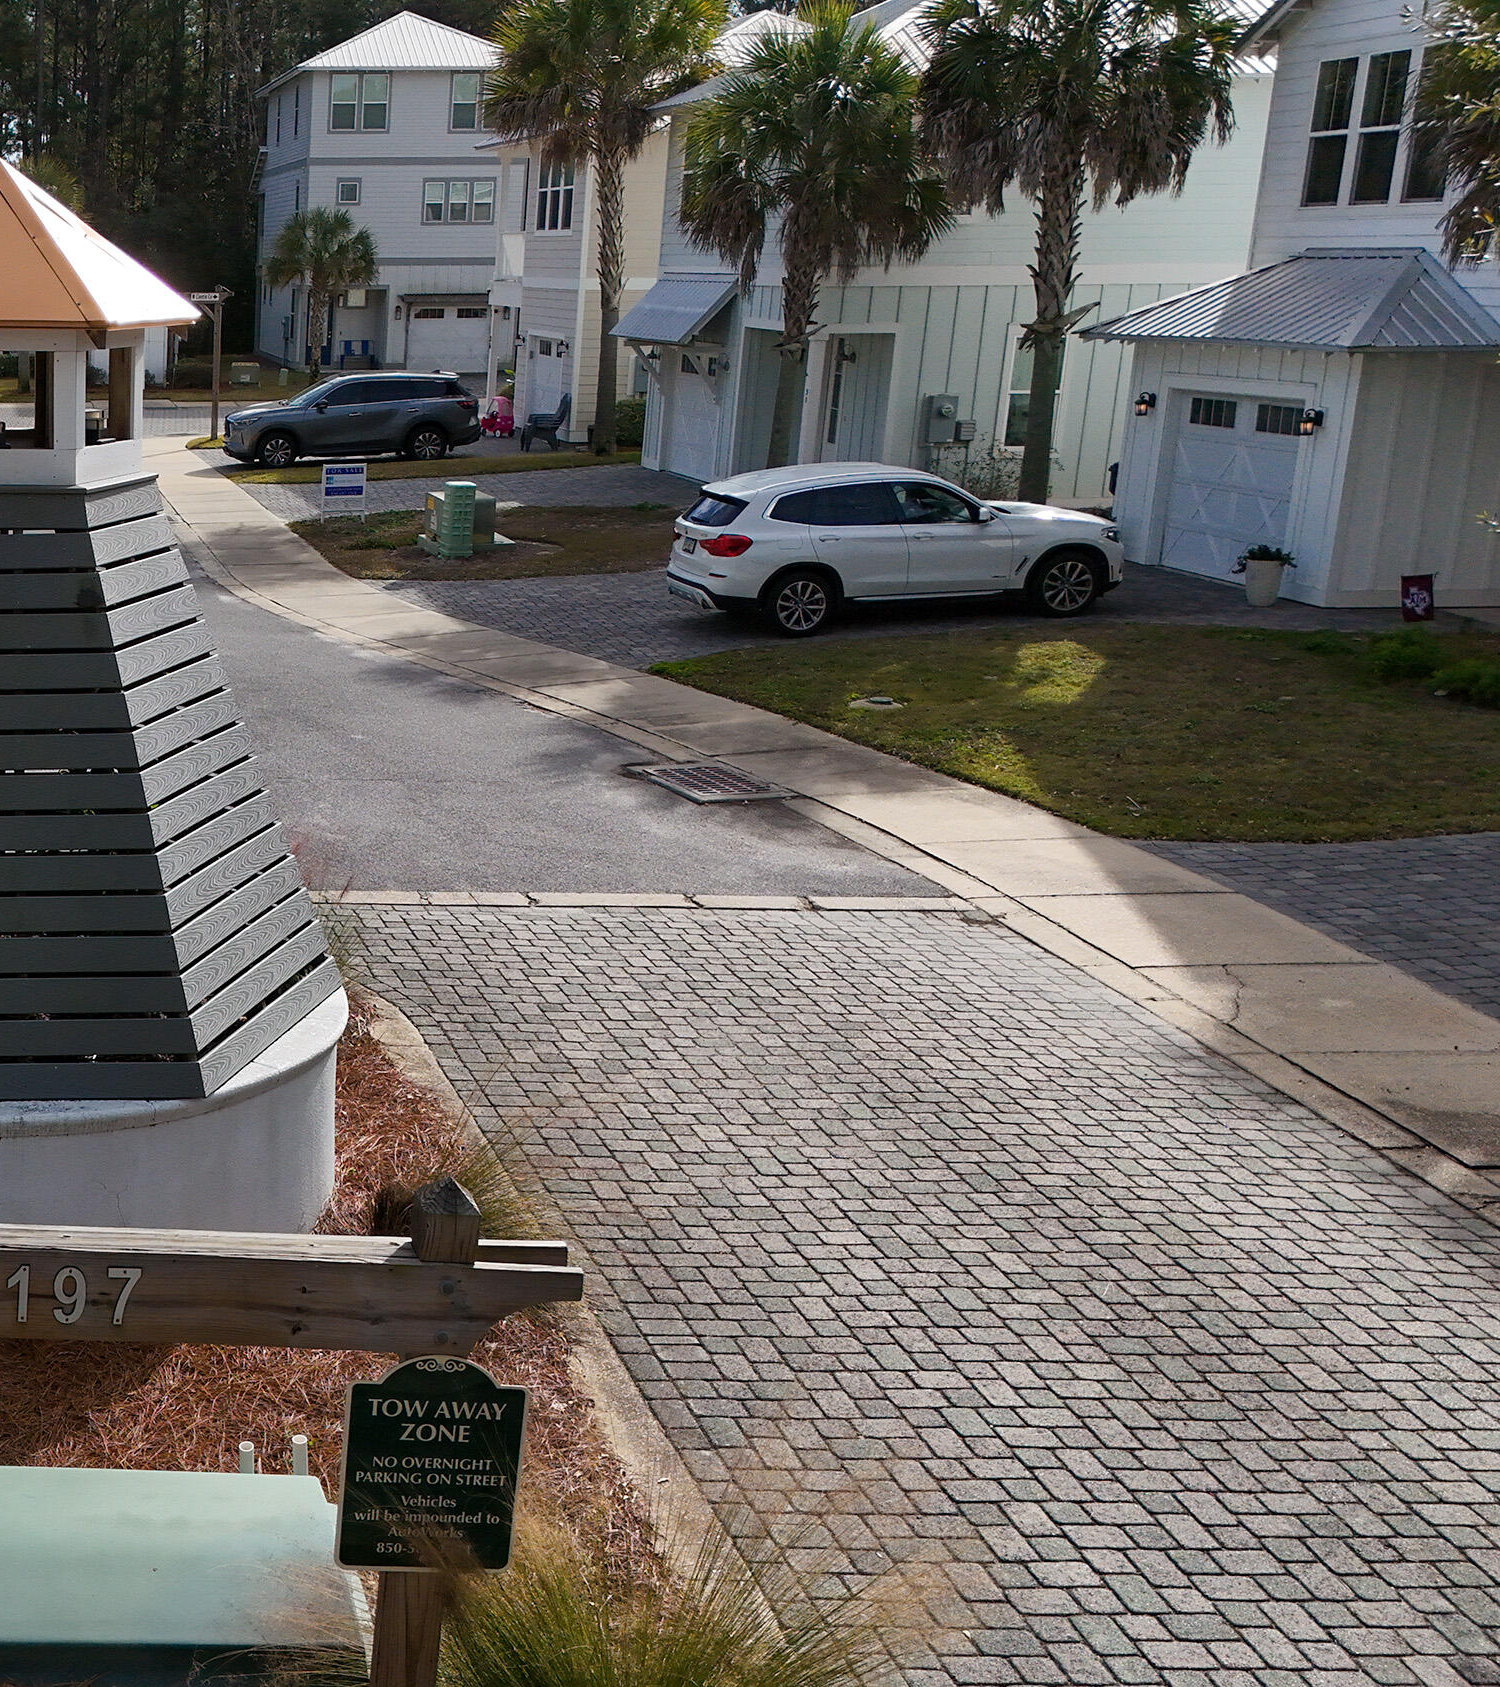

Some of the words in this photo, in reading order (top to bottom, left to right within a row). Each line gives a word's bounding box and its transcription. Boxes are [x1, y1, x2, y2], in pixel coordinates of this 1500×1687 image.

[6, 1263, 143, 1326] 197
[368, 1398, 430, 1418] TOW
[434, 1400, 507, 1421] AWAY
[399, 1423, 471, 1443] ZONE
[372, 1455, 397, 1469] NO
[402, 1456, 493, 1471] OVERNIGHT
[355, 1471, 423, 1485] PARKING
[426, 1472, 452, 1486] ON
[456, 1473, 507, 1487] STREET
[401, 1495, 457, 1508] Vehicles
[355, 1509, 380, 1521] will
[384, 1509, 401, 1522] be
[404, 1510, 482, 1526] impounded
[486, 1513, 500, 1525] to
